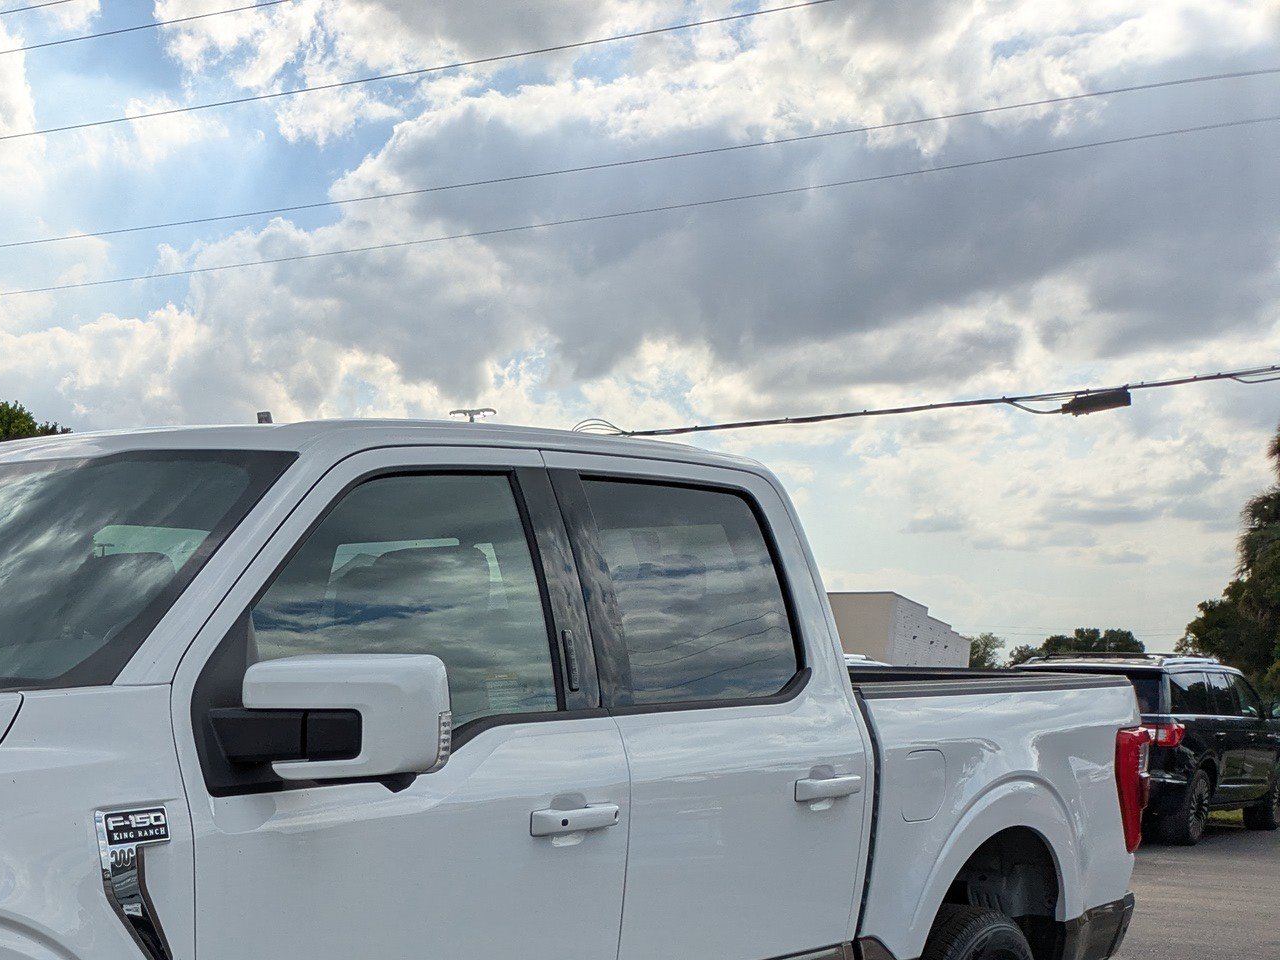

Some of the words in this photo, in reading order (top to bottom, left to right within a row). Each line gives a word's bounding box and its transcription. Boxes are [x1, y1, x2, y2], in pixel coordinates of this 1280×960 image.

[107, 811, 166, 831] F-150
[113, 831, 135, 841] KING
[137, 827, 167, 838] RANCH
